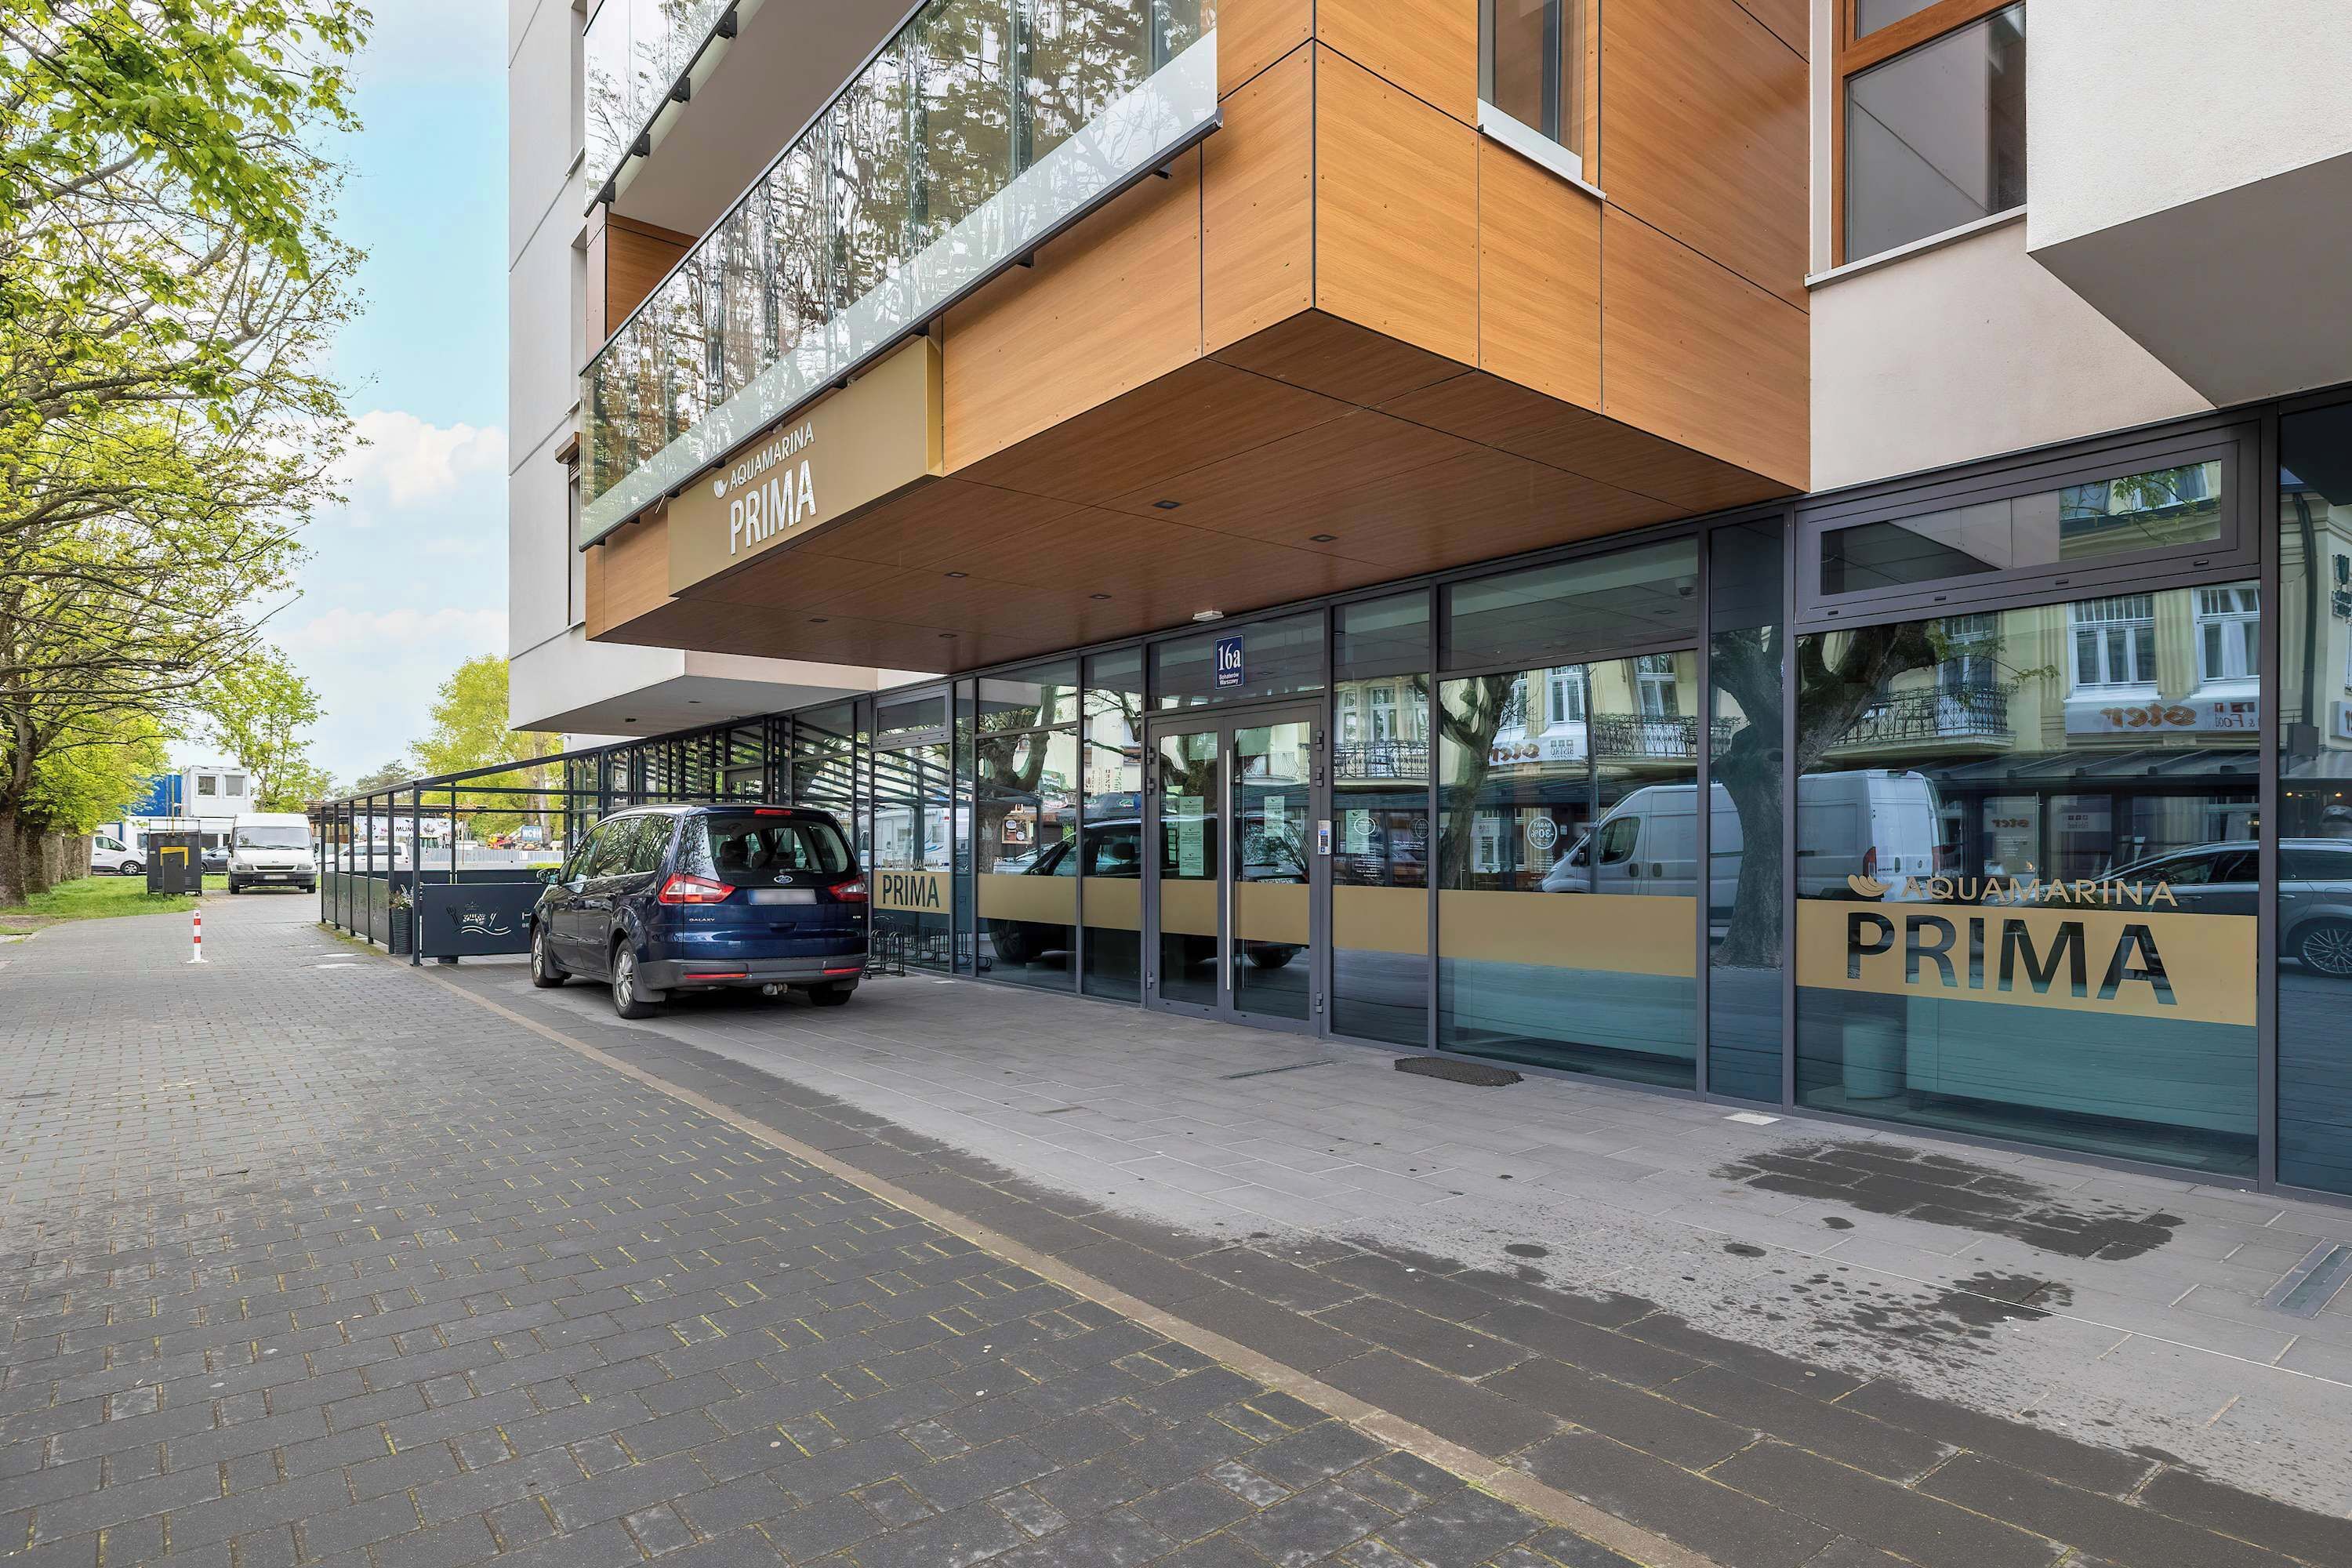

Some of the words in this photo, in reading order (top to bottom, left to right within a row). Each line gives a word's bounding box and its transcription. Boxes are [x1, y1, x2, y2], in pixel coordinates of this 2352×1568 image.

[729, 419, 815, 492] AQUAMARINA
[730, 459, 817, 556] PRIMA
[1218, 643, 1241, 671] 16a
[883, 874, 939, 908] PRIMA
[1900, 876, 2179, 907] AQUAMARINA
[1846, 912, 2178, 1006] PRIMA
